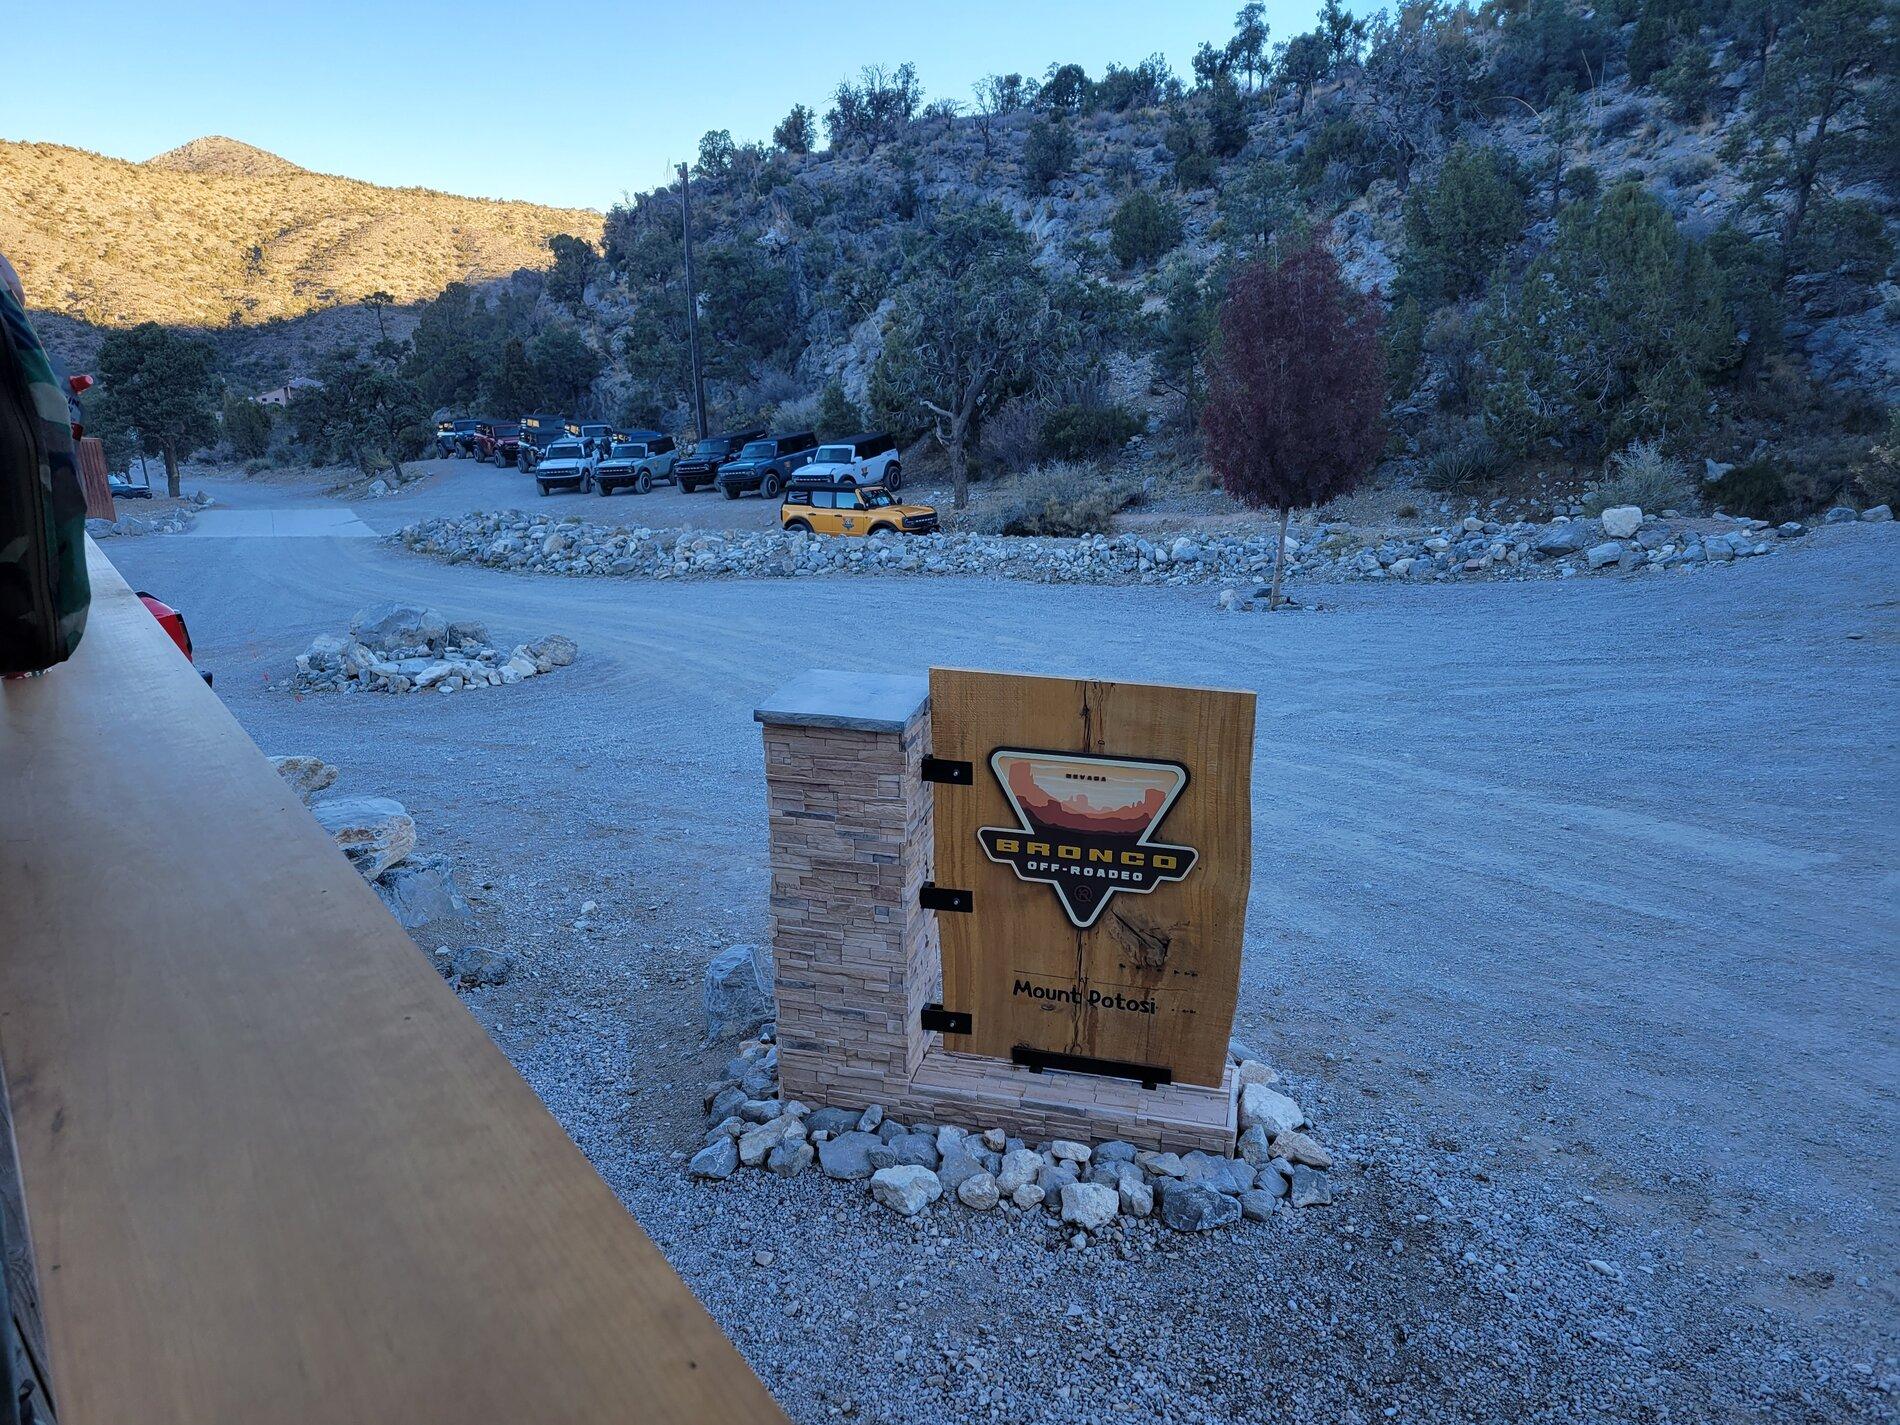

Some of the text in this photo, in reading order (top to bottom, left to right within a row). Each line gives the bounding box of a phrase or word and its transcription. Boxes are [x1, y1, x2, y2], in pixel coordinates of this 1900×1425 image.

[1065, 773, 1107, 782] NEVADA
[996, 838, 1177, 870] BRONCO
[1027, 861, 1143, 882] OFF-ROADEO
[1012, 979, 1157, 1015] Mount Potosi
